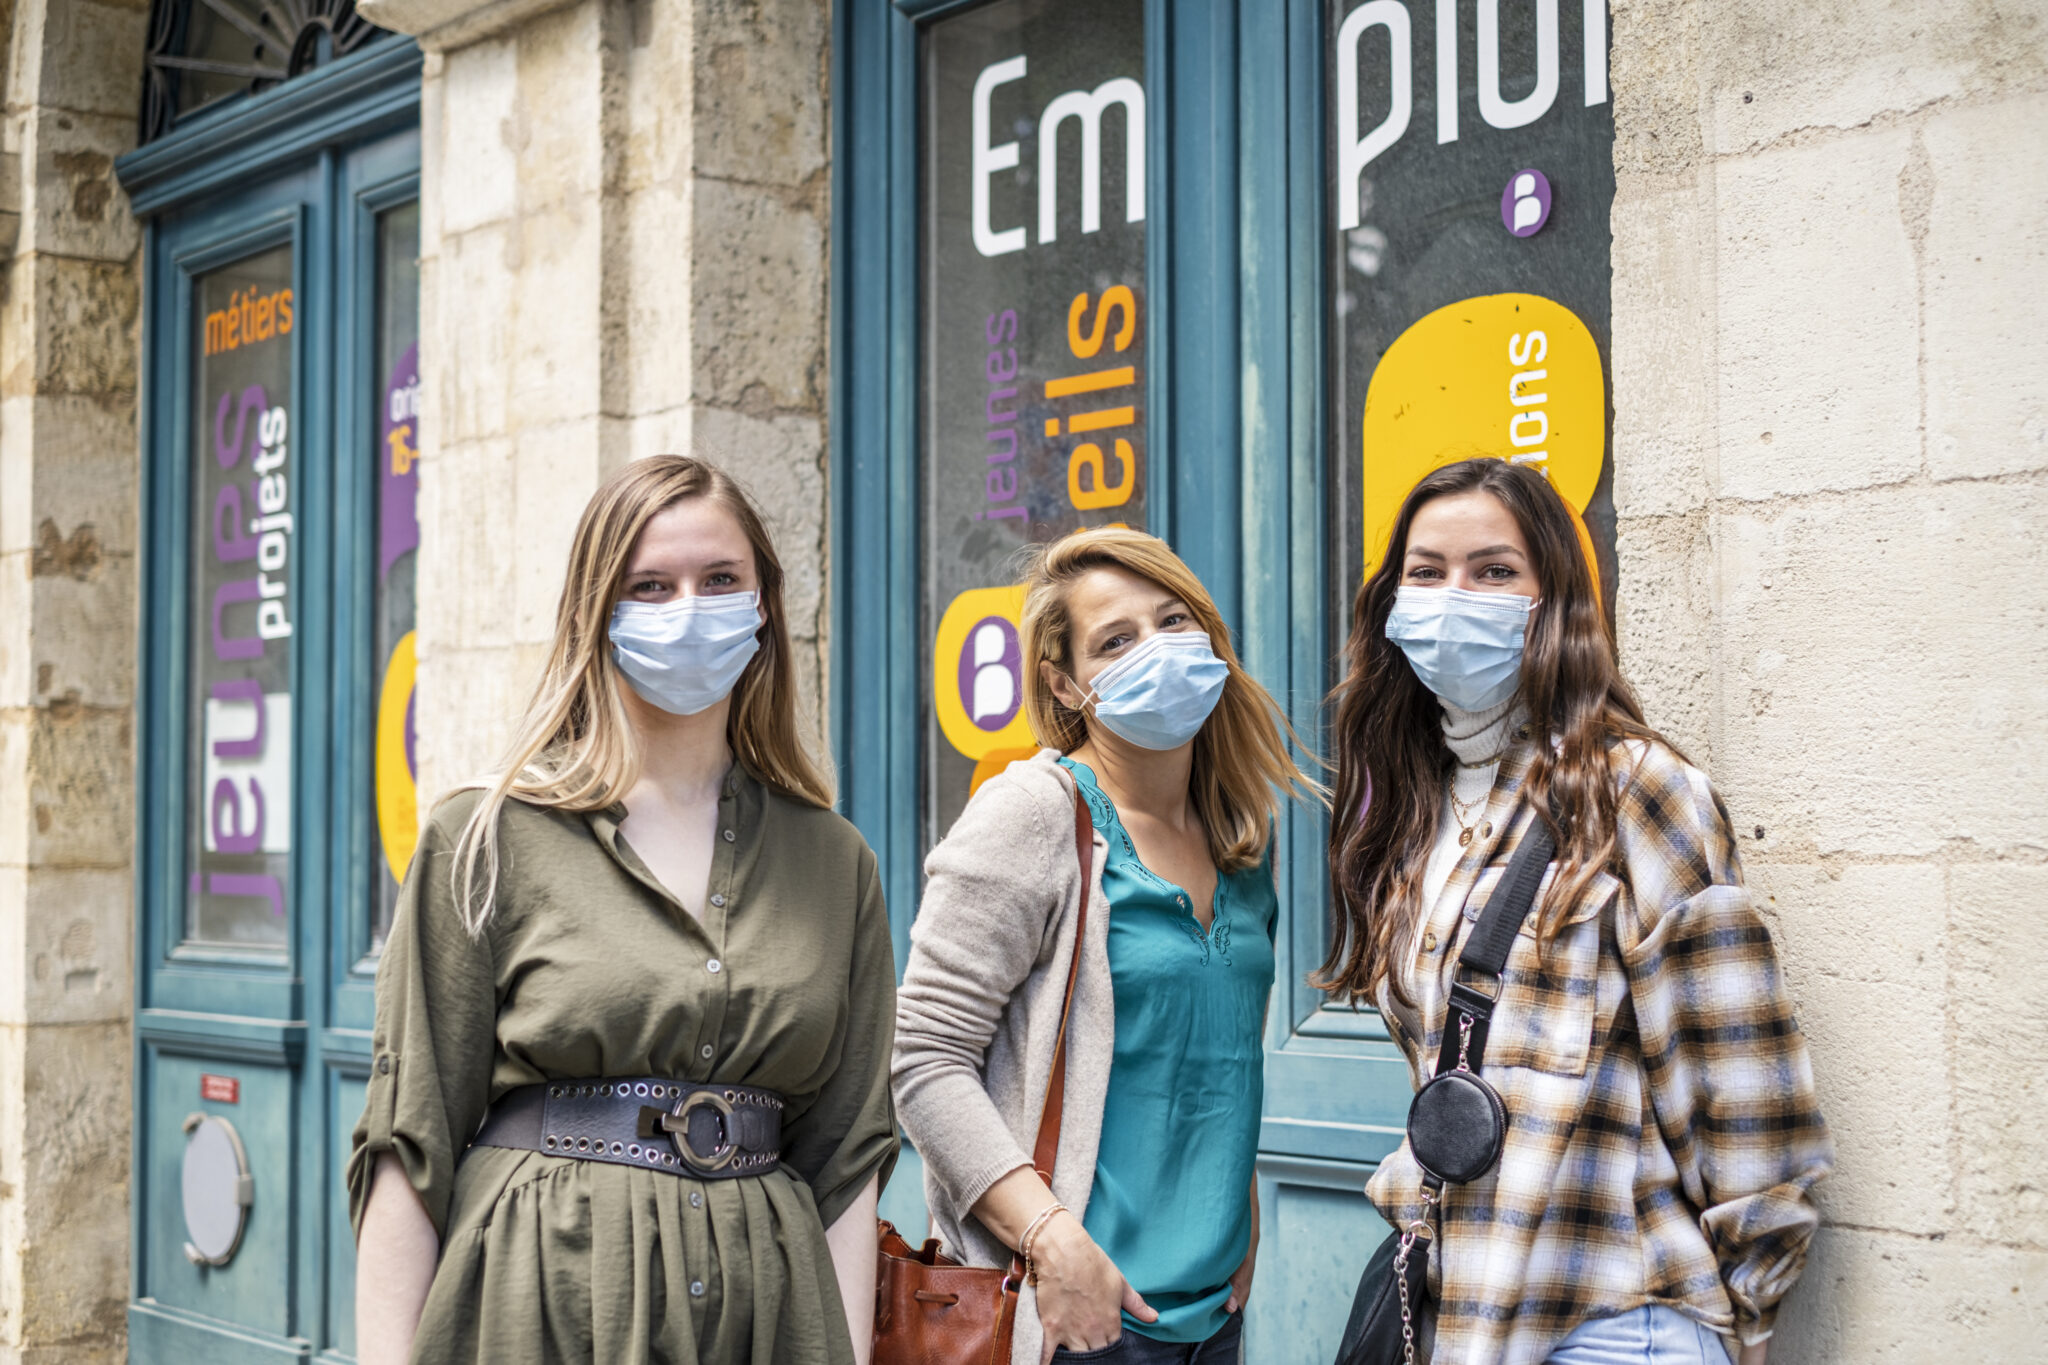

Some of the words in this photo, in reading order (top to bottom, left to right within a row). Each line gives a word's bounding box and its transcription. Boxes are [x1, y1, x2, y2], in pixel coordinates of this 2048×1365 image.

[972, 54, 1146, 257] Em
[205, 285, 294, 356] métiers
[974, 308, 1028, 522] jeunes
[1044, 283, 1136, 533] eils
[1500, 329, 1549, 478] ions
[251, 405, 293, 640] projets
[189, 384, 284, 916] jeunes
